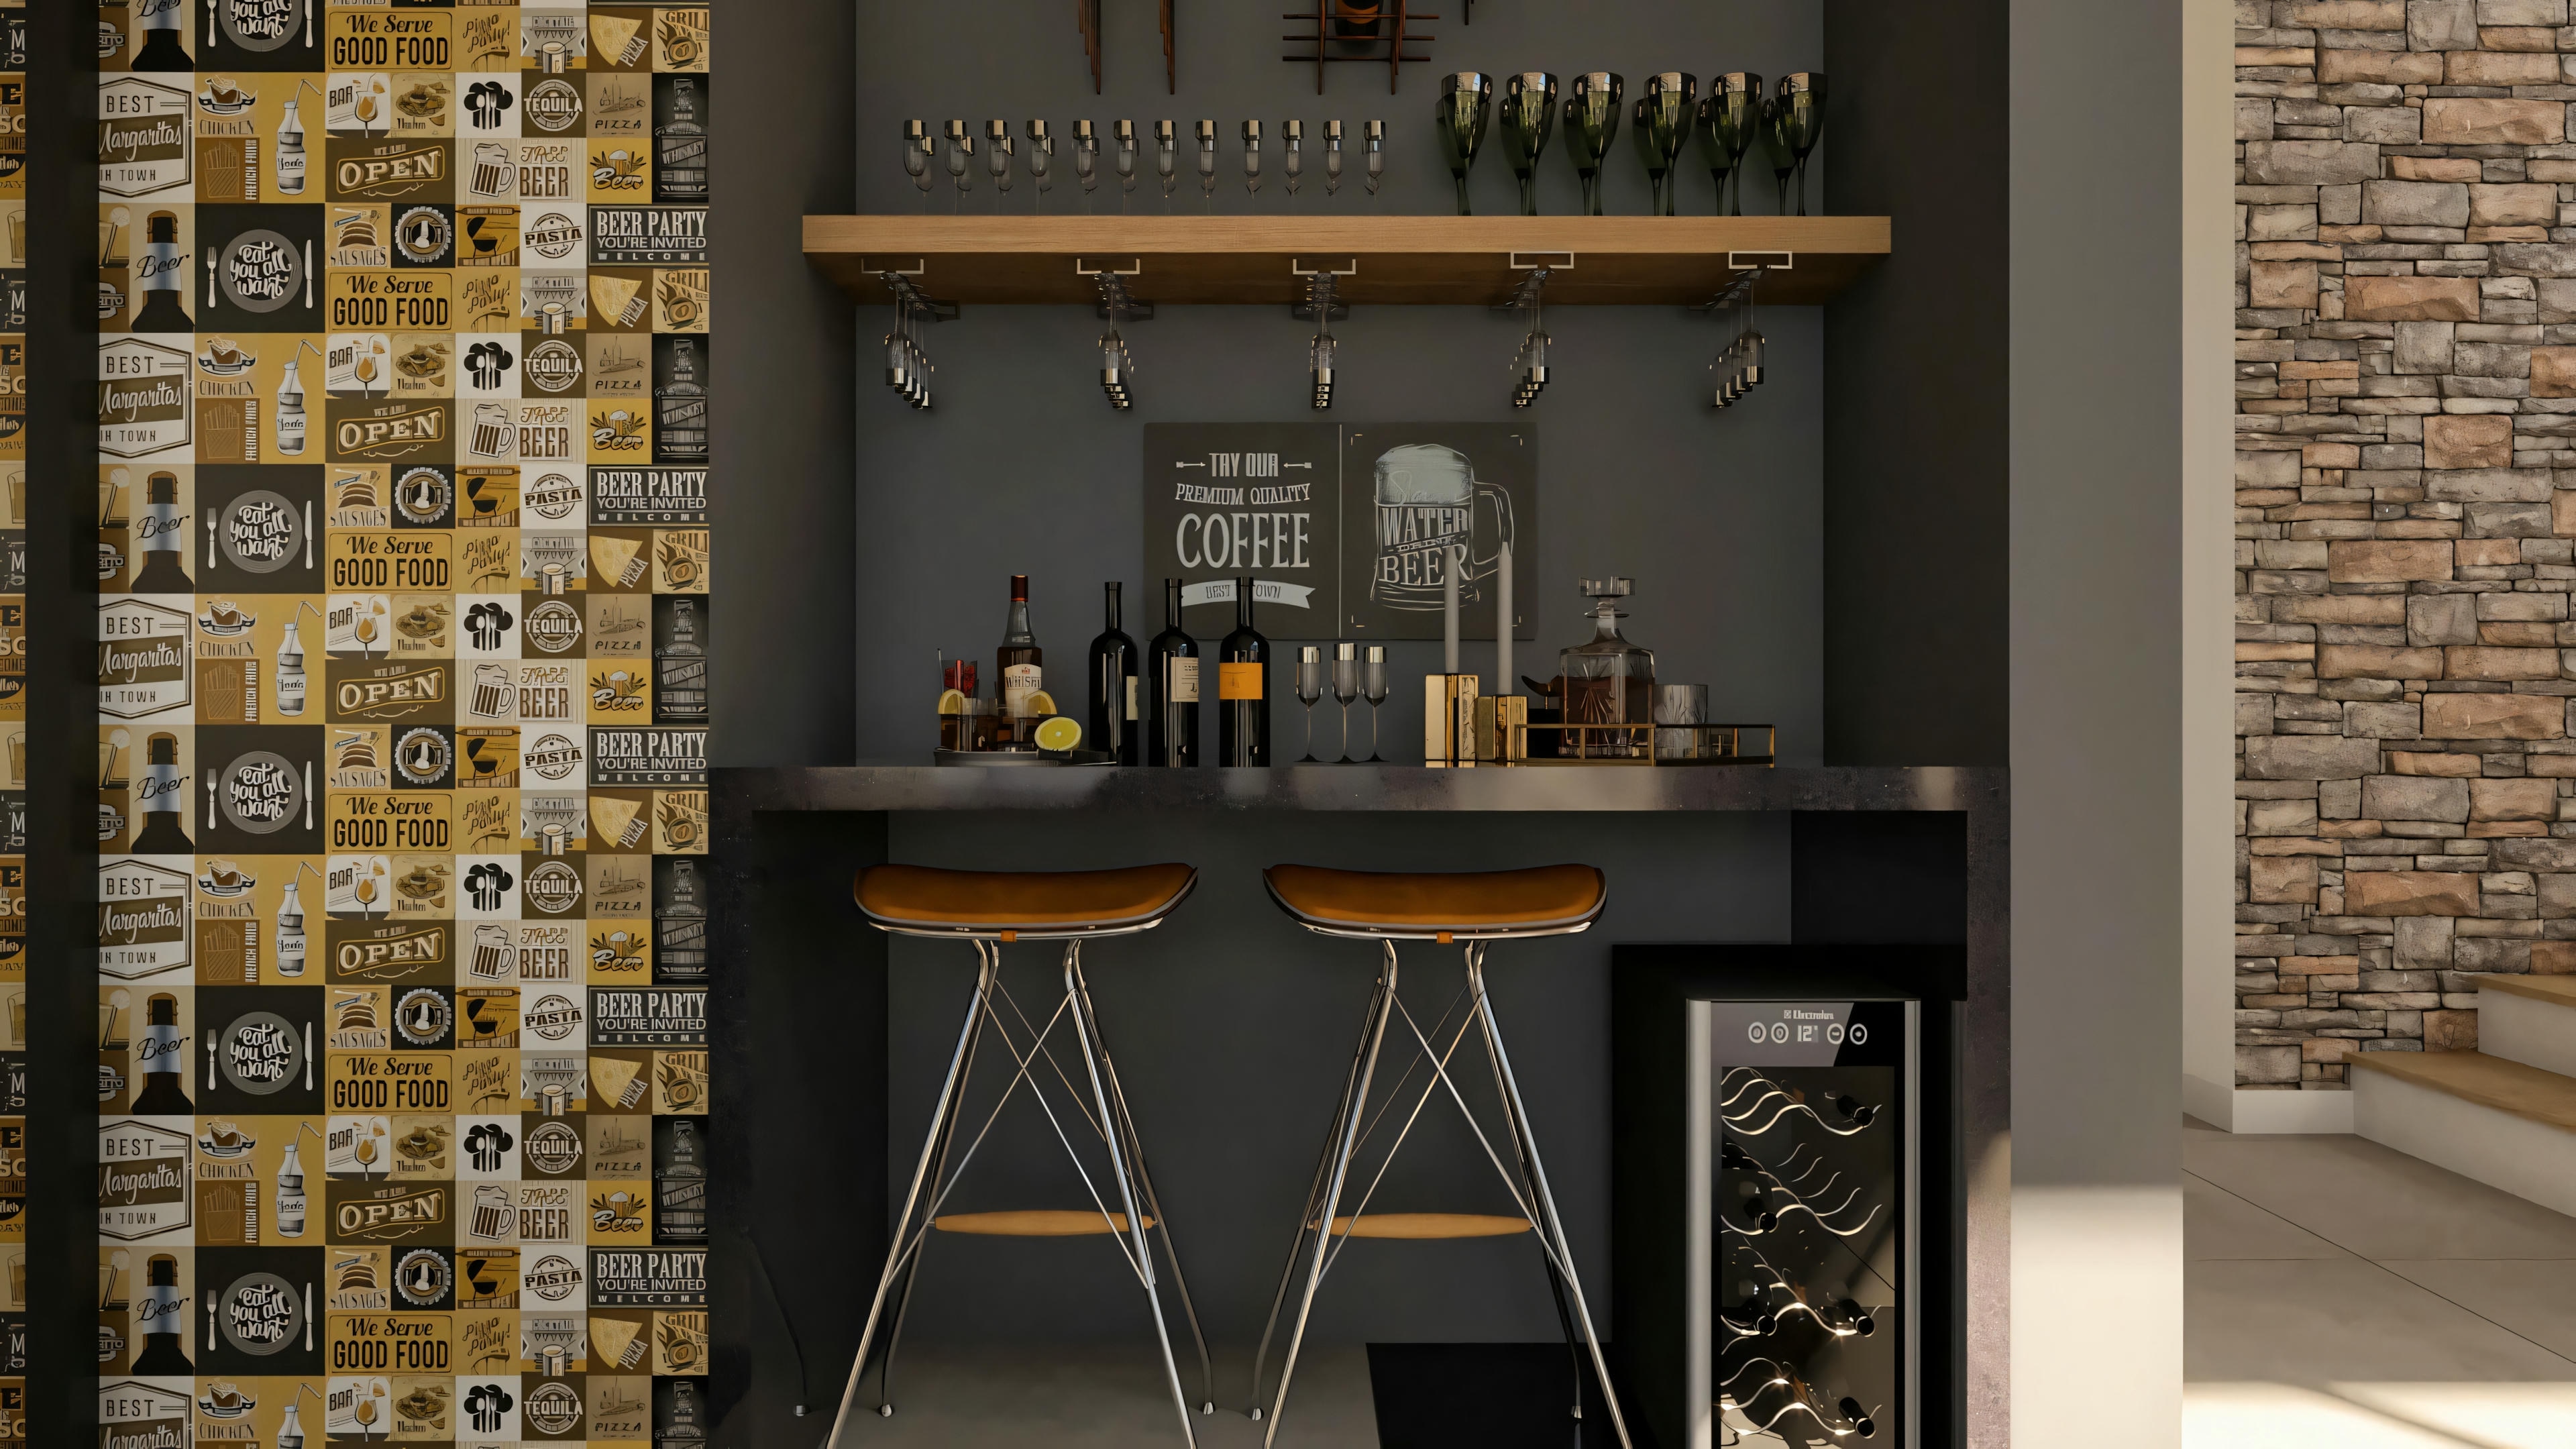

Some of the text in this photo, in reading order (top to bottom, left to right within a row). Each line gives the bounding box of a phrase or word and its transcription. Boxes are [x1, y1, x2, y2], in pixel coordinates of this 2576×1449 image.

[230, 1, 262, 23] you
[347, 15, 433, 33] We Serve
[237, 15, 288, 39] want
[335, 38, 448, 65] GOOD FOOD
[107, 96, 154, 113] BEST
[523, 97, 583, 113] TEQUILA
[339, 151, 441, 186] OPEN
[520, 167, 568, 197] BEER
[597, 211, 707, 236] BEER PARTY
[525, 229, 582, 246] PASTA
[597, 237, 706, 249] YOU'RE INVITED
[238, 241, 272, 264] eat
[134, 255, 191, 281] Beer
[230, 248, 291, 283] you all
[237, 275, 288, 299] want
[347, 275, 433, 293] We Serve
[335, 298, 448, 325] GOOD FOOD
[107, 356, 154, 373] BEST
[523, 358, 583, 373] TEQUILA
[339, 411, 441, 447] OPEN
[520, 427, 568, 457] BEER
[597, 472, 707, 496] BEER PARTY
[1175, 483, 1311, 505] PREMIUM QUALITY
[525, 489, 582, 506] PASTA
[597, 497, 706, 509] YOU'RE INVITED
[238, 502, 272, 524] eat
[134, 515, 191, 541] Beer
[230, 508, 291, 543] you all
[237, 535, 288, 559] want
[347, 535, 433, 553] We Serve
[1176, 513, 1310, 568] COFFEE
[335, 558, 448, 586] GOOD FOOD
[107, 617, 154, 634] BEST
[523, 619, 583, 634] TEQUILA
[339, 672, 441, 708] OPEN
[520, 688, 568, 718] BEER
[597, 733, 707, 757] BEER PARTY
[525, 750, 582, 767] PASTA
[597, 758, 706, 770] YOU'RE INVITED
[238, 763, 272, 785] eat
[134, 776, 191, 802] Beer
[230, 769, 291, 804] you all
[237, 796, 288, 820] want
[347, 796, 433, 814] We Serve
[335, 819, 448, 847] GOOD FOOD
[107, 878, 154, 895] BEST
[523, 879, 583, 895] TEQUILA
[339, 933, 441, 969] OPEN
[520, 949, 568, 979] BEER
[597, 994, 707, 1018] BEER PARTY
[525, 1011, 582, 1028] PASTA
[597, 1019, 706, 1031] YOU'RE INVITED
[238, 1024, 272, 1046] eat
[134, 1037, 191, 1063] Beer
[230, 1030, 291, 1065] you all
[237, 1057, 288, 1081] want
[347, 1057, 433, 1075] We Serve
[335, 1080, 448, 1108] GOOD FOOD
[107, 1138, 154, 1155] BEST
[523, 1140, 583, 1155] TEQUILA
[339, 1193, 441, 1229] OPEN
[520, 1210, 568, 1239] BEER
[597, 1254, 707, 1279] BEER PARTY
[525, 1271, 582, 1288] PASTA
[597, 1279, 706, 1291] YOU'RE INVITED
[238, 1284, 272, 1306] eat
[134, 1297, 191, 1324] Beer
[230, 1290, 291, 1326] you all
[237, 1318, 288, 1342] want
[347, 1318, 433, 1336] We Serve
[335, 1340, 448, 1368] GOOD FOOD
[107, 1399, 154, 1415] BEST
[523, 1400, 583, 1415] TEQUILA
